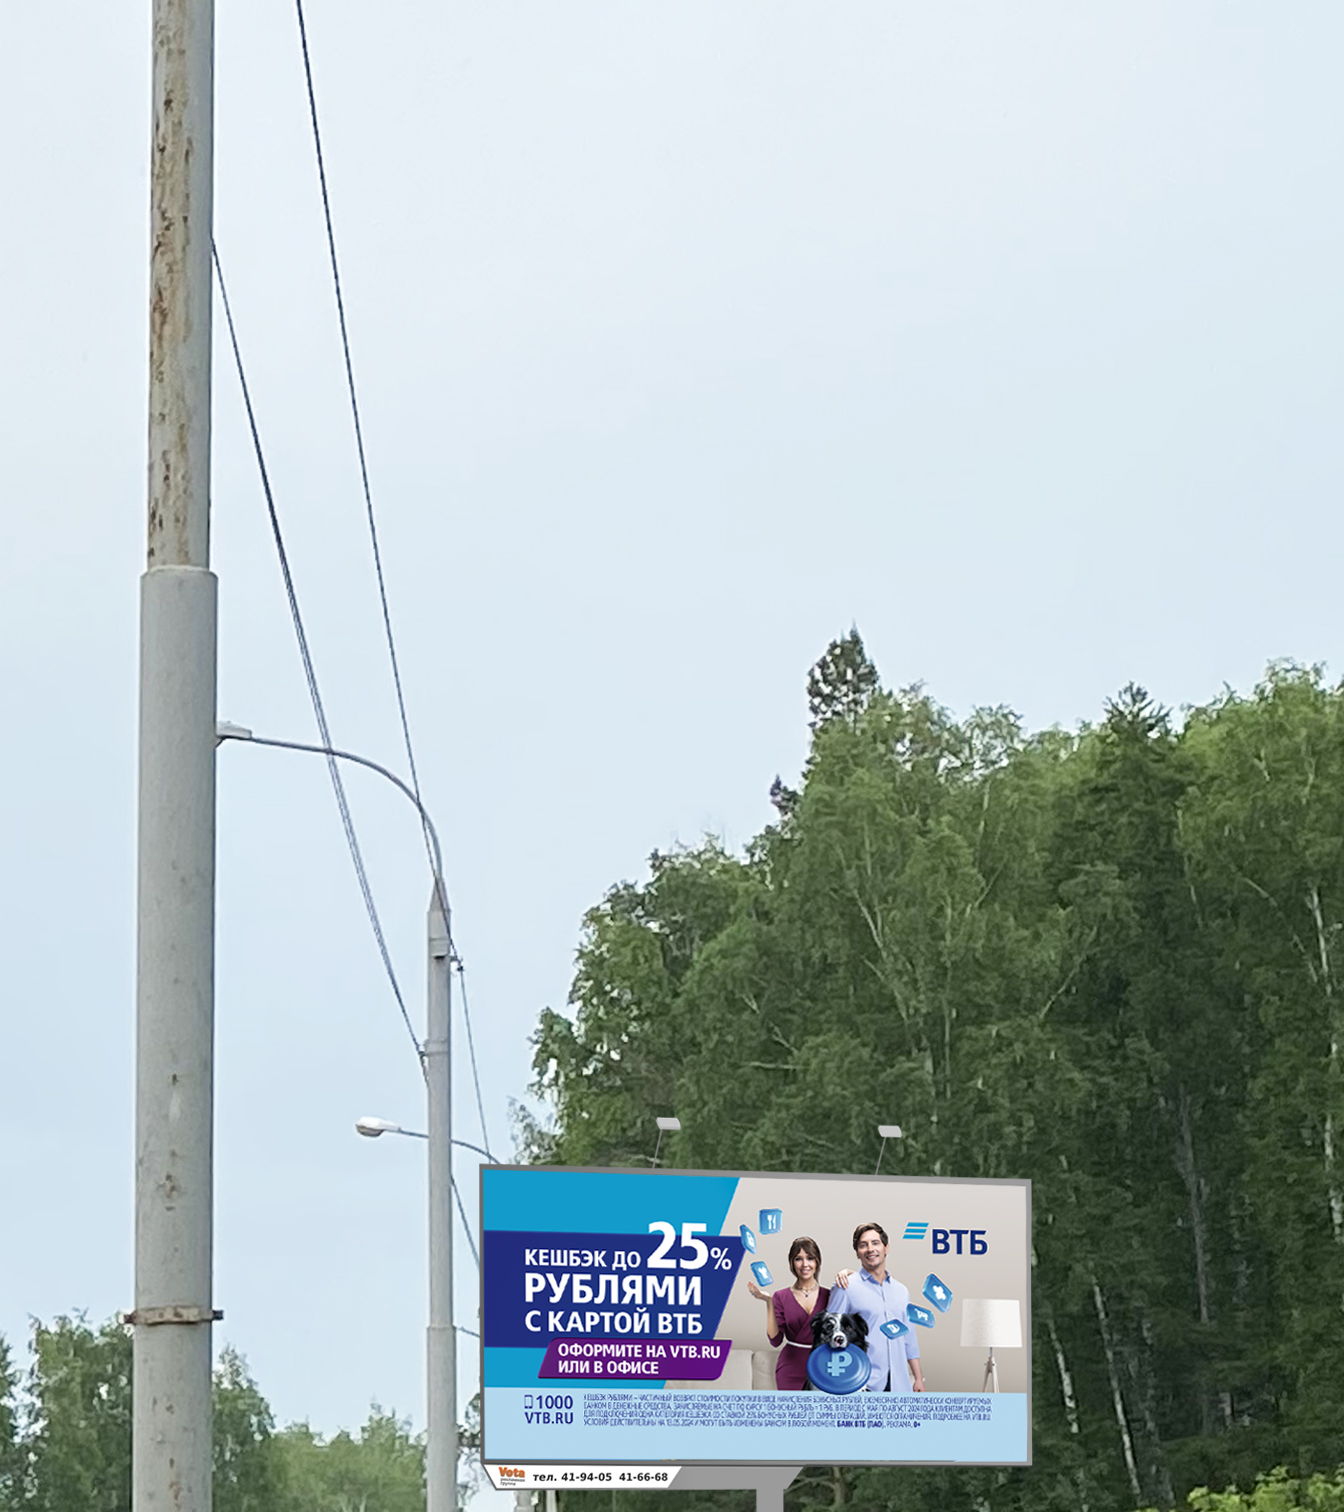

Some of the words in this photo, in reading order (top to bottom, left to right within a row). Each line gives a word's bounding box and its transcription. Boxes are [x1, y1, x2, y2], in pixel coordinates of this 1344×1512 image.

[525, 1249, 607, 1267] КЕШБЭК
[612, 1251, 641, 1270] ДО
[647, 1221, 732, 1270] 25%
[932, 1229, 988, 1255] ВТБ
[525, 1272, 702, 1306] РУБЛЯМИ
[525, 1310, 541, 1332] С
[548, 1307, 650, 1334] КАРТОЙ
[658, 1313, 703, 1334] ВТБ
[558, 1343, 643, 1358] ОФОРМИТЕ
[646, 1345, 667, 1358] НА
[670, 1345, 720, 1359] VTB.RU
[558, 1360, 590, 1374] ИЛИ
[594, 1361, 603, 1374] В
[607, 1361, 659, 1375] ОФИСЕ
[536, 1394, 574, 1410] 1000
[525, 1411, 574, 1425] VTB.RU
[499, 1467, 525, 1478] Vota
[533, 1474, 557, 1482] тел.
[561, 1472, 612, 1481] 41-94-05
[619, 1472, 668, 1481] 41-66-68
